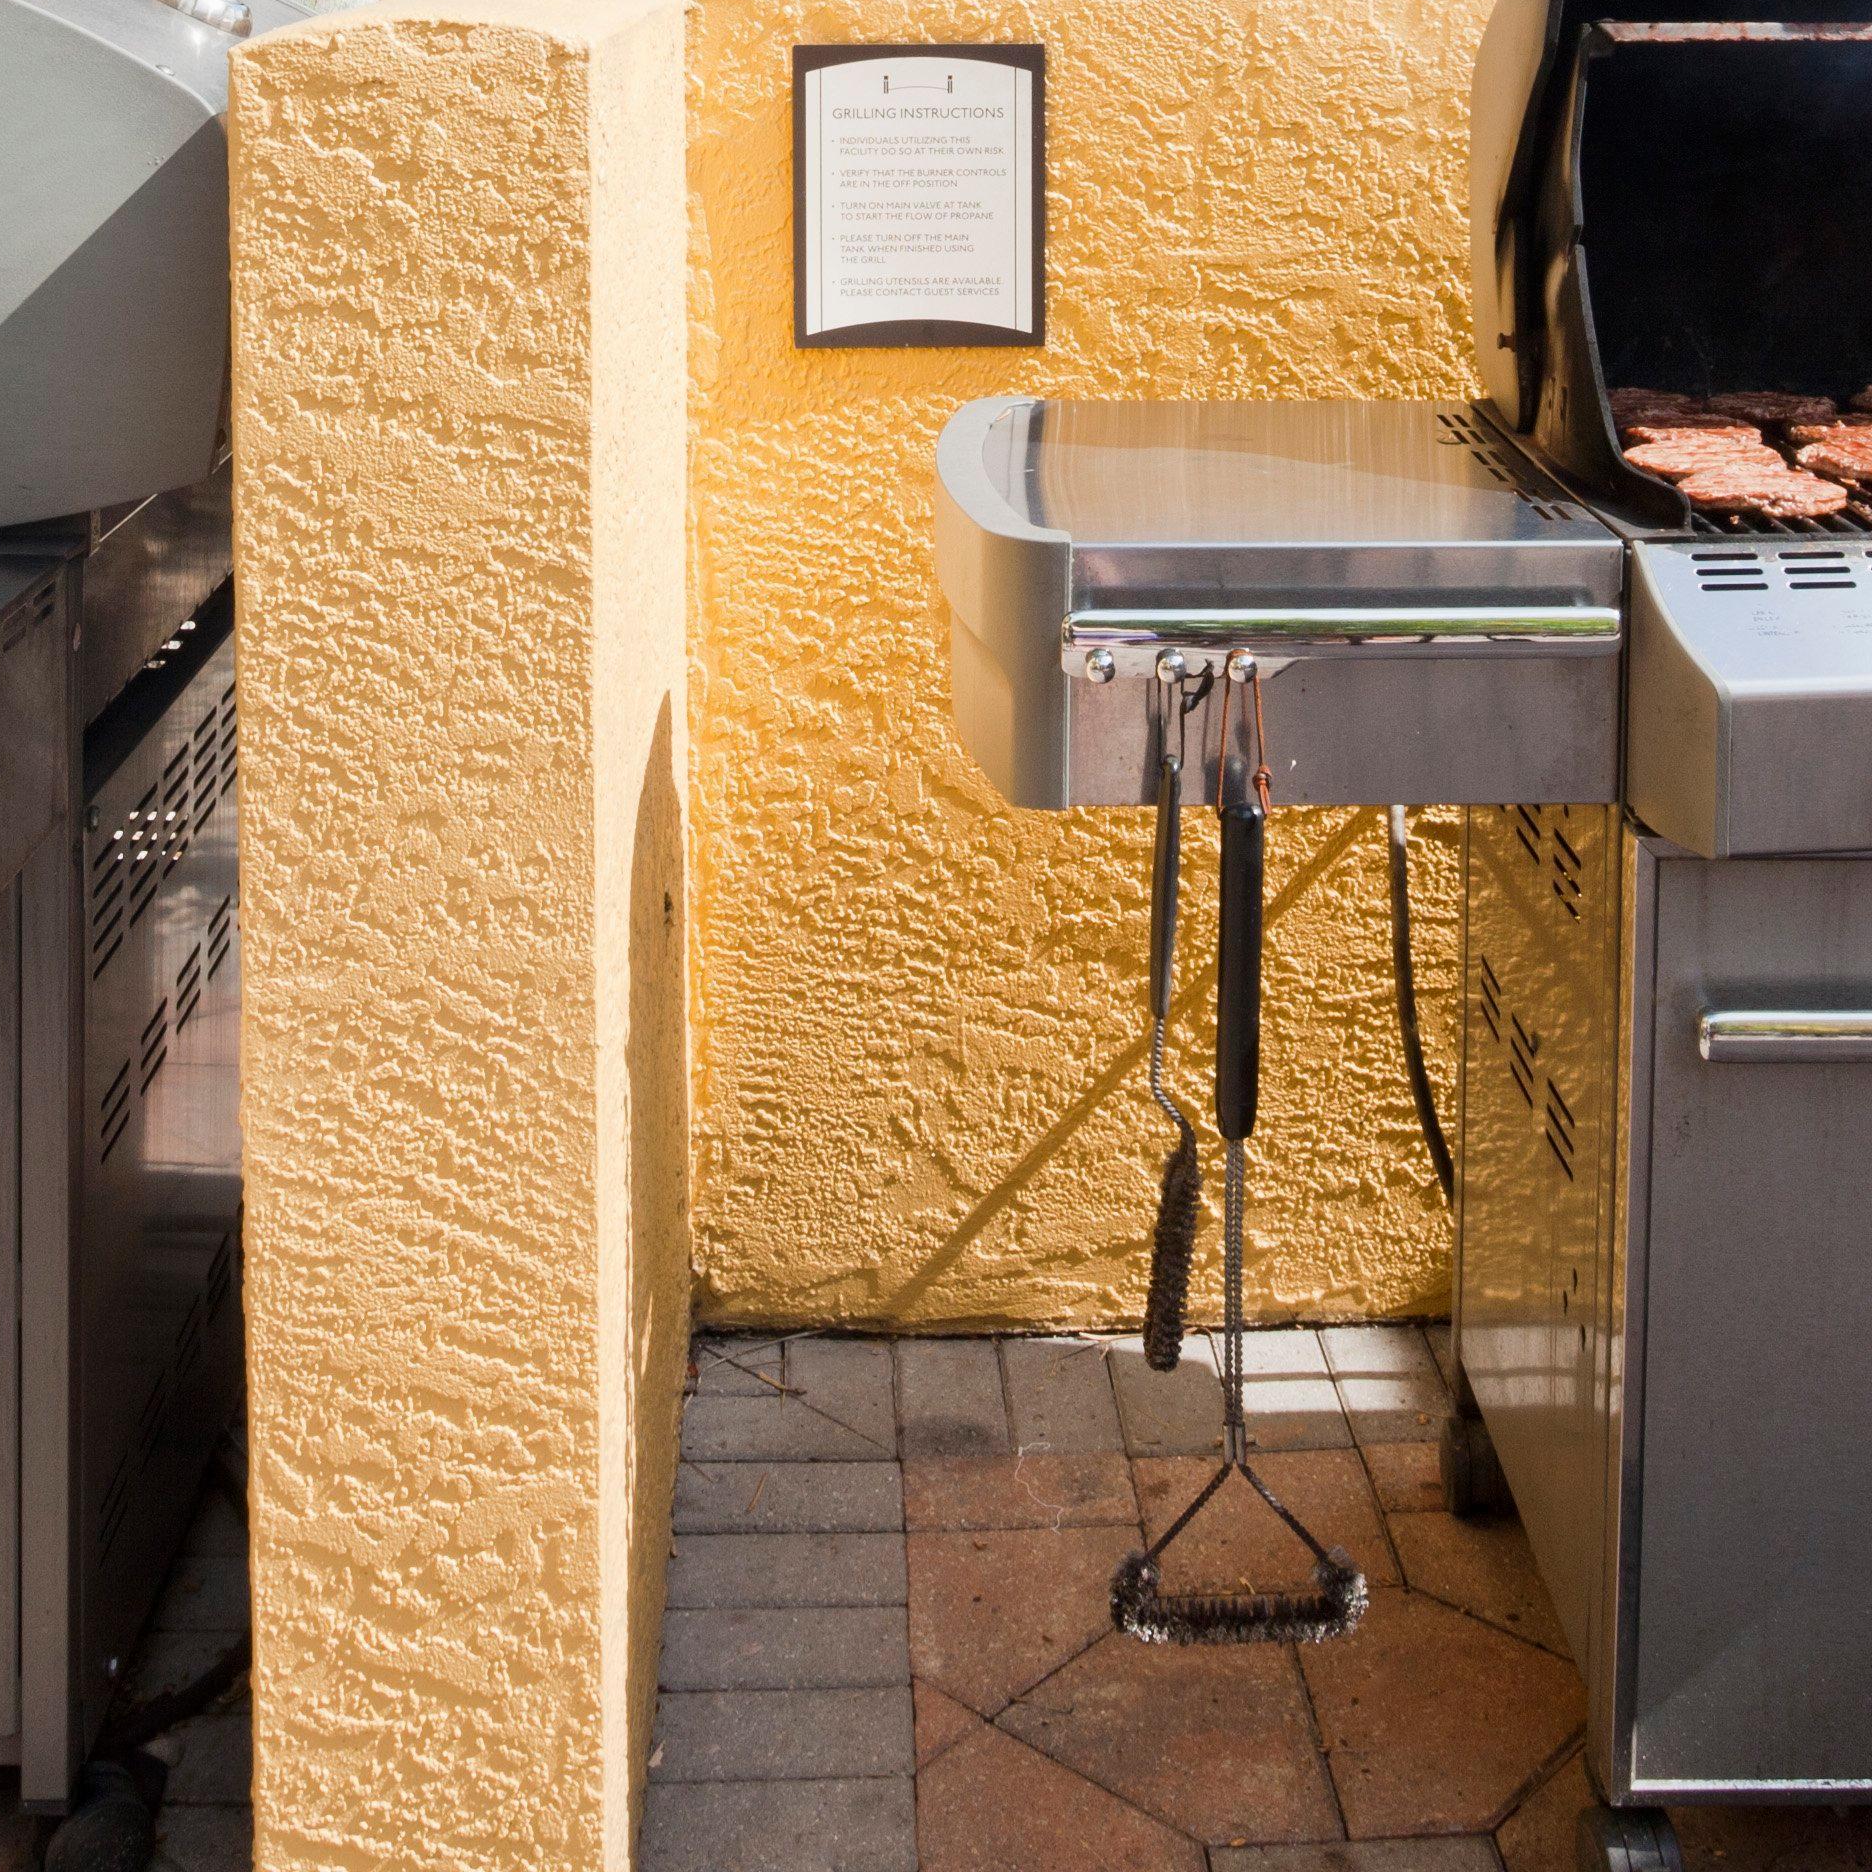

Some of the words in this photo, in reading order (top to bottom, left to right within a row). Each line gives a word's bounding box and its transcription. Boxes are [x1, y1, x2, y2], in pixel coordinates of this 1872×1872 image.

[832, 107, 897, 119] GRILLING
[900, 107, 1005, 119] INSTRUCTIONS
[839, 136, 900, 145] INDIVIDUALS
[901, 136, 948, 145] UTILIZING
[950, 136, 971, 145] THIS
[839, 147, 878, 156] FACILITY
[881, 147, 896, 156] DO
[898, 147, 912, 156] SO
[914, 147, 926, 156] AT
[928, 147, 954, 156] THEIR
[956, 147, 982, 156] OWN
[840, 169, 870, 178] VERIFY
[872, 169, 895, 178] THAT
[897, 169, 914, 178] THE
[917, 169, 953, 178] BURNER
[956, 169, 1007, 178] CONTROLS
[839, 180, 857, 188] ARE
[859, 180, 870, 188] IN
[873, 180, 889, 188] THE
[892, 180, 909, 188] OFF
[912, 180, 958, 188] POSITION
[840, 201, 867, 210] TURN
[868, 201, 884, 210] ON
[886, 201, 911, 210] MAIN
[913, 201, 941, 210] VALVE
[943, 201, 955, 210] AT
[957, 201, 981, 210] TANK
[840, 212, 853, 221] TO
[855, 212, 882, 221] START
[885, 212, 902, 221] THE
[905, 212, 932, 221] FLOW
[934, 212, 948, 221] OF
[950, 212, 994, 221] PROPANE
[840, 234, 873, 243] PLEASE
[875, 234, 902, 243] TURN
[904, 234, 921, 243] OFF
[924, 234, 942, 243] THE
[944, 234, 969, 243] MAIN
[840, 245, 864, 253] TANK
[867, 245, 897, 253] WHEN
[899, 245, 942, 253] FINISHED
[944, 245, 974, 253] USING
[840, 256, 858, 264] THE
[861, 256, 886, 264] GRILL
[840, 277, 884, 286] GRILLING
[885, 277, 930, 286] UTENSILS
[932, 277, 949, 286] ARE
[840, 288, 873, 297] PLEASE
[875, 288, 922, 297] CONTACT
[924, 288, 954, 297] GUEST
[956, 288, 1000, 297] SERVICES
